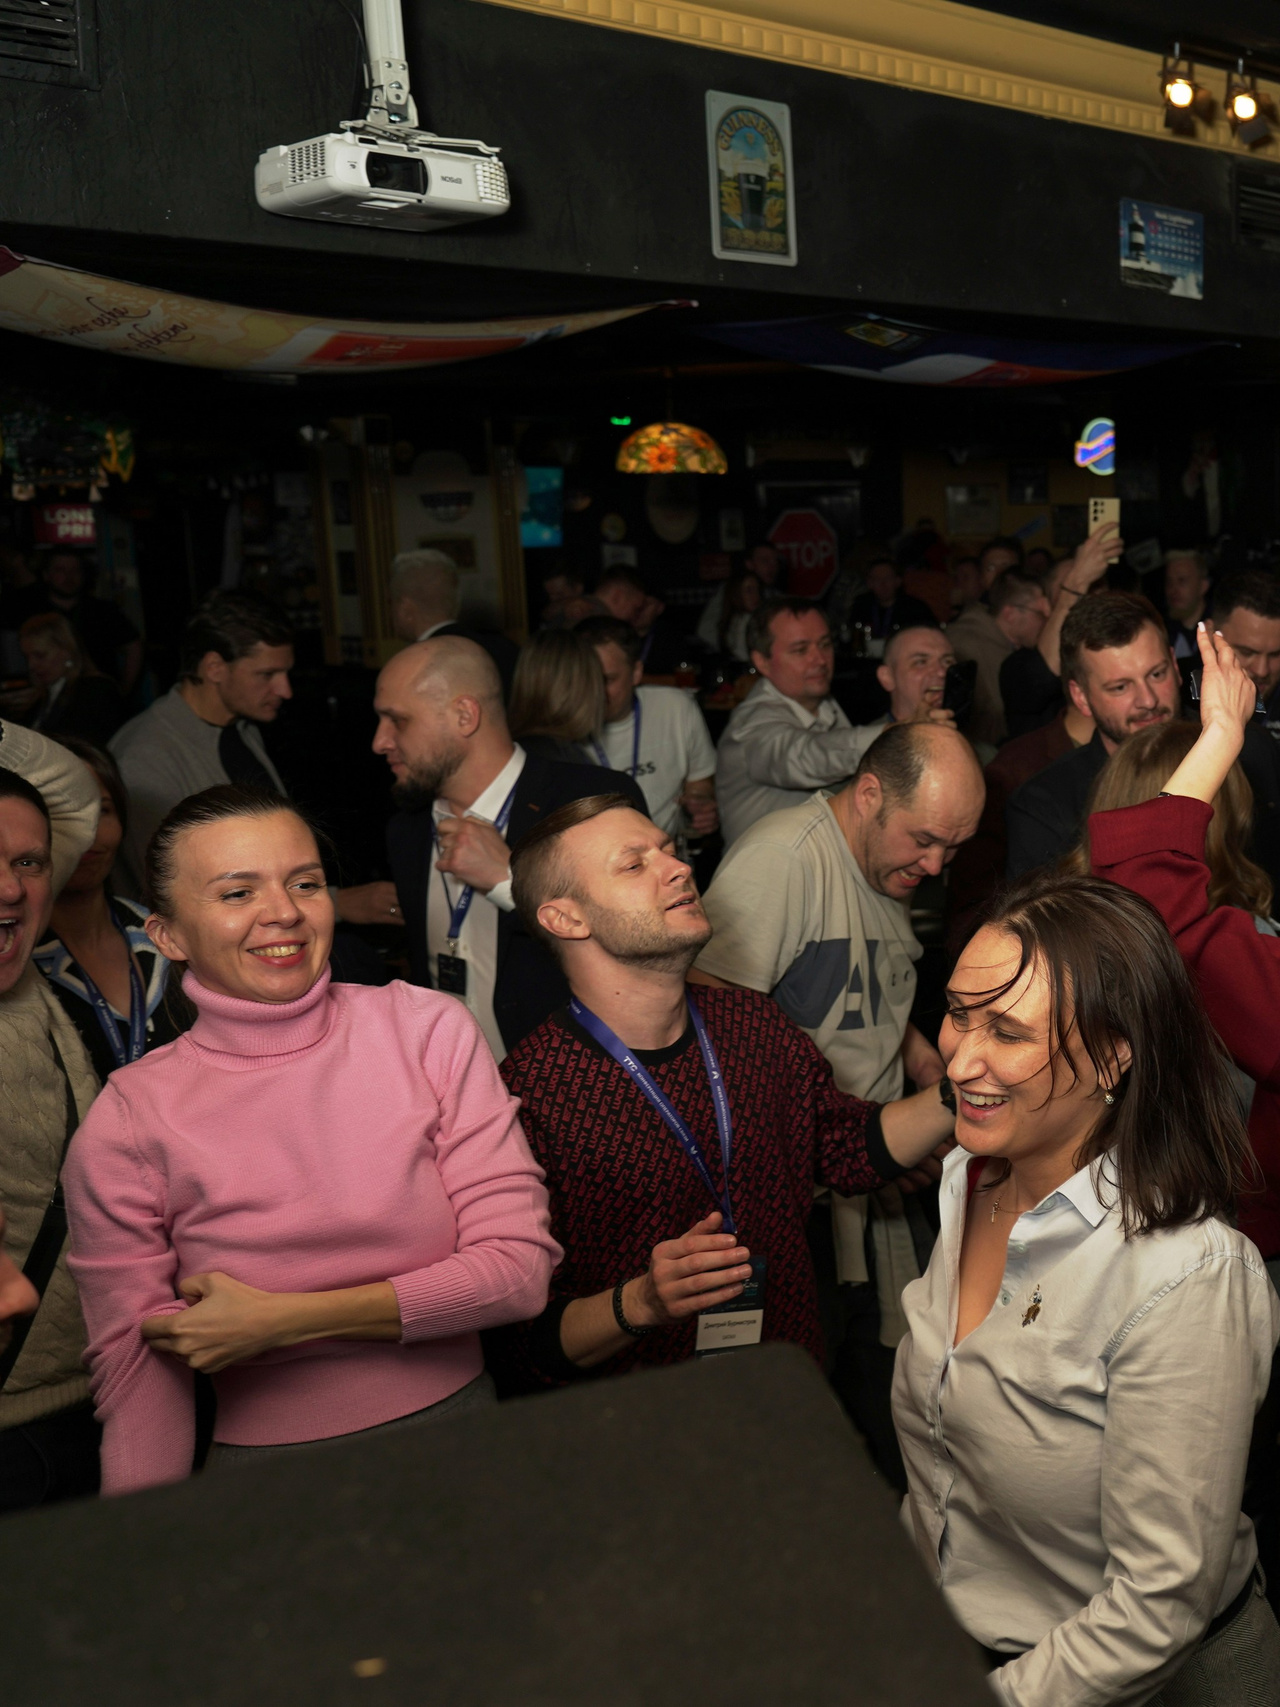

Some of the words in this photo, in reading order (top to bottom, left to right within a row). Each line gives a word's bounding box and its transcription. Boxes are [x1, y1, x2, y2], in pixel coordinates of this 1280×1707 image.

[719, 111, 780, 156] GUINNESS
[440, 175, 462, 185] EPSON
[659, 1101, 681, 1129] ОПЕРАТОРОВ
